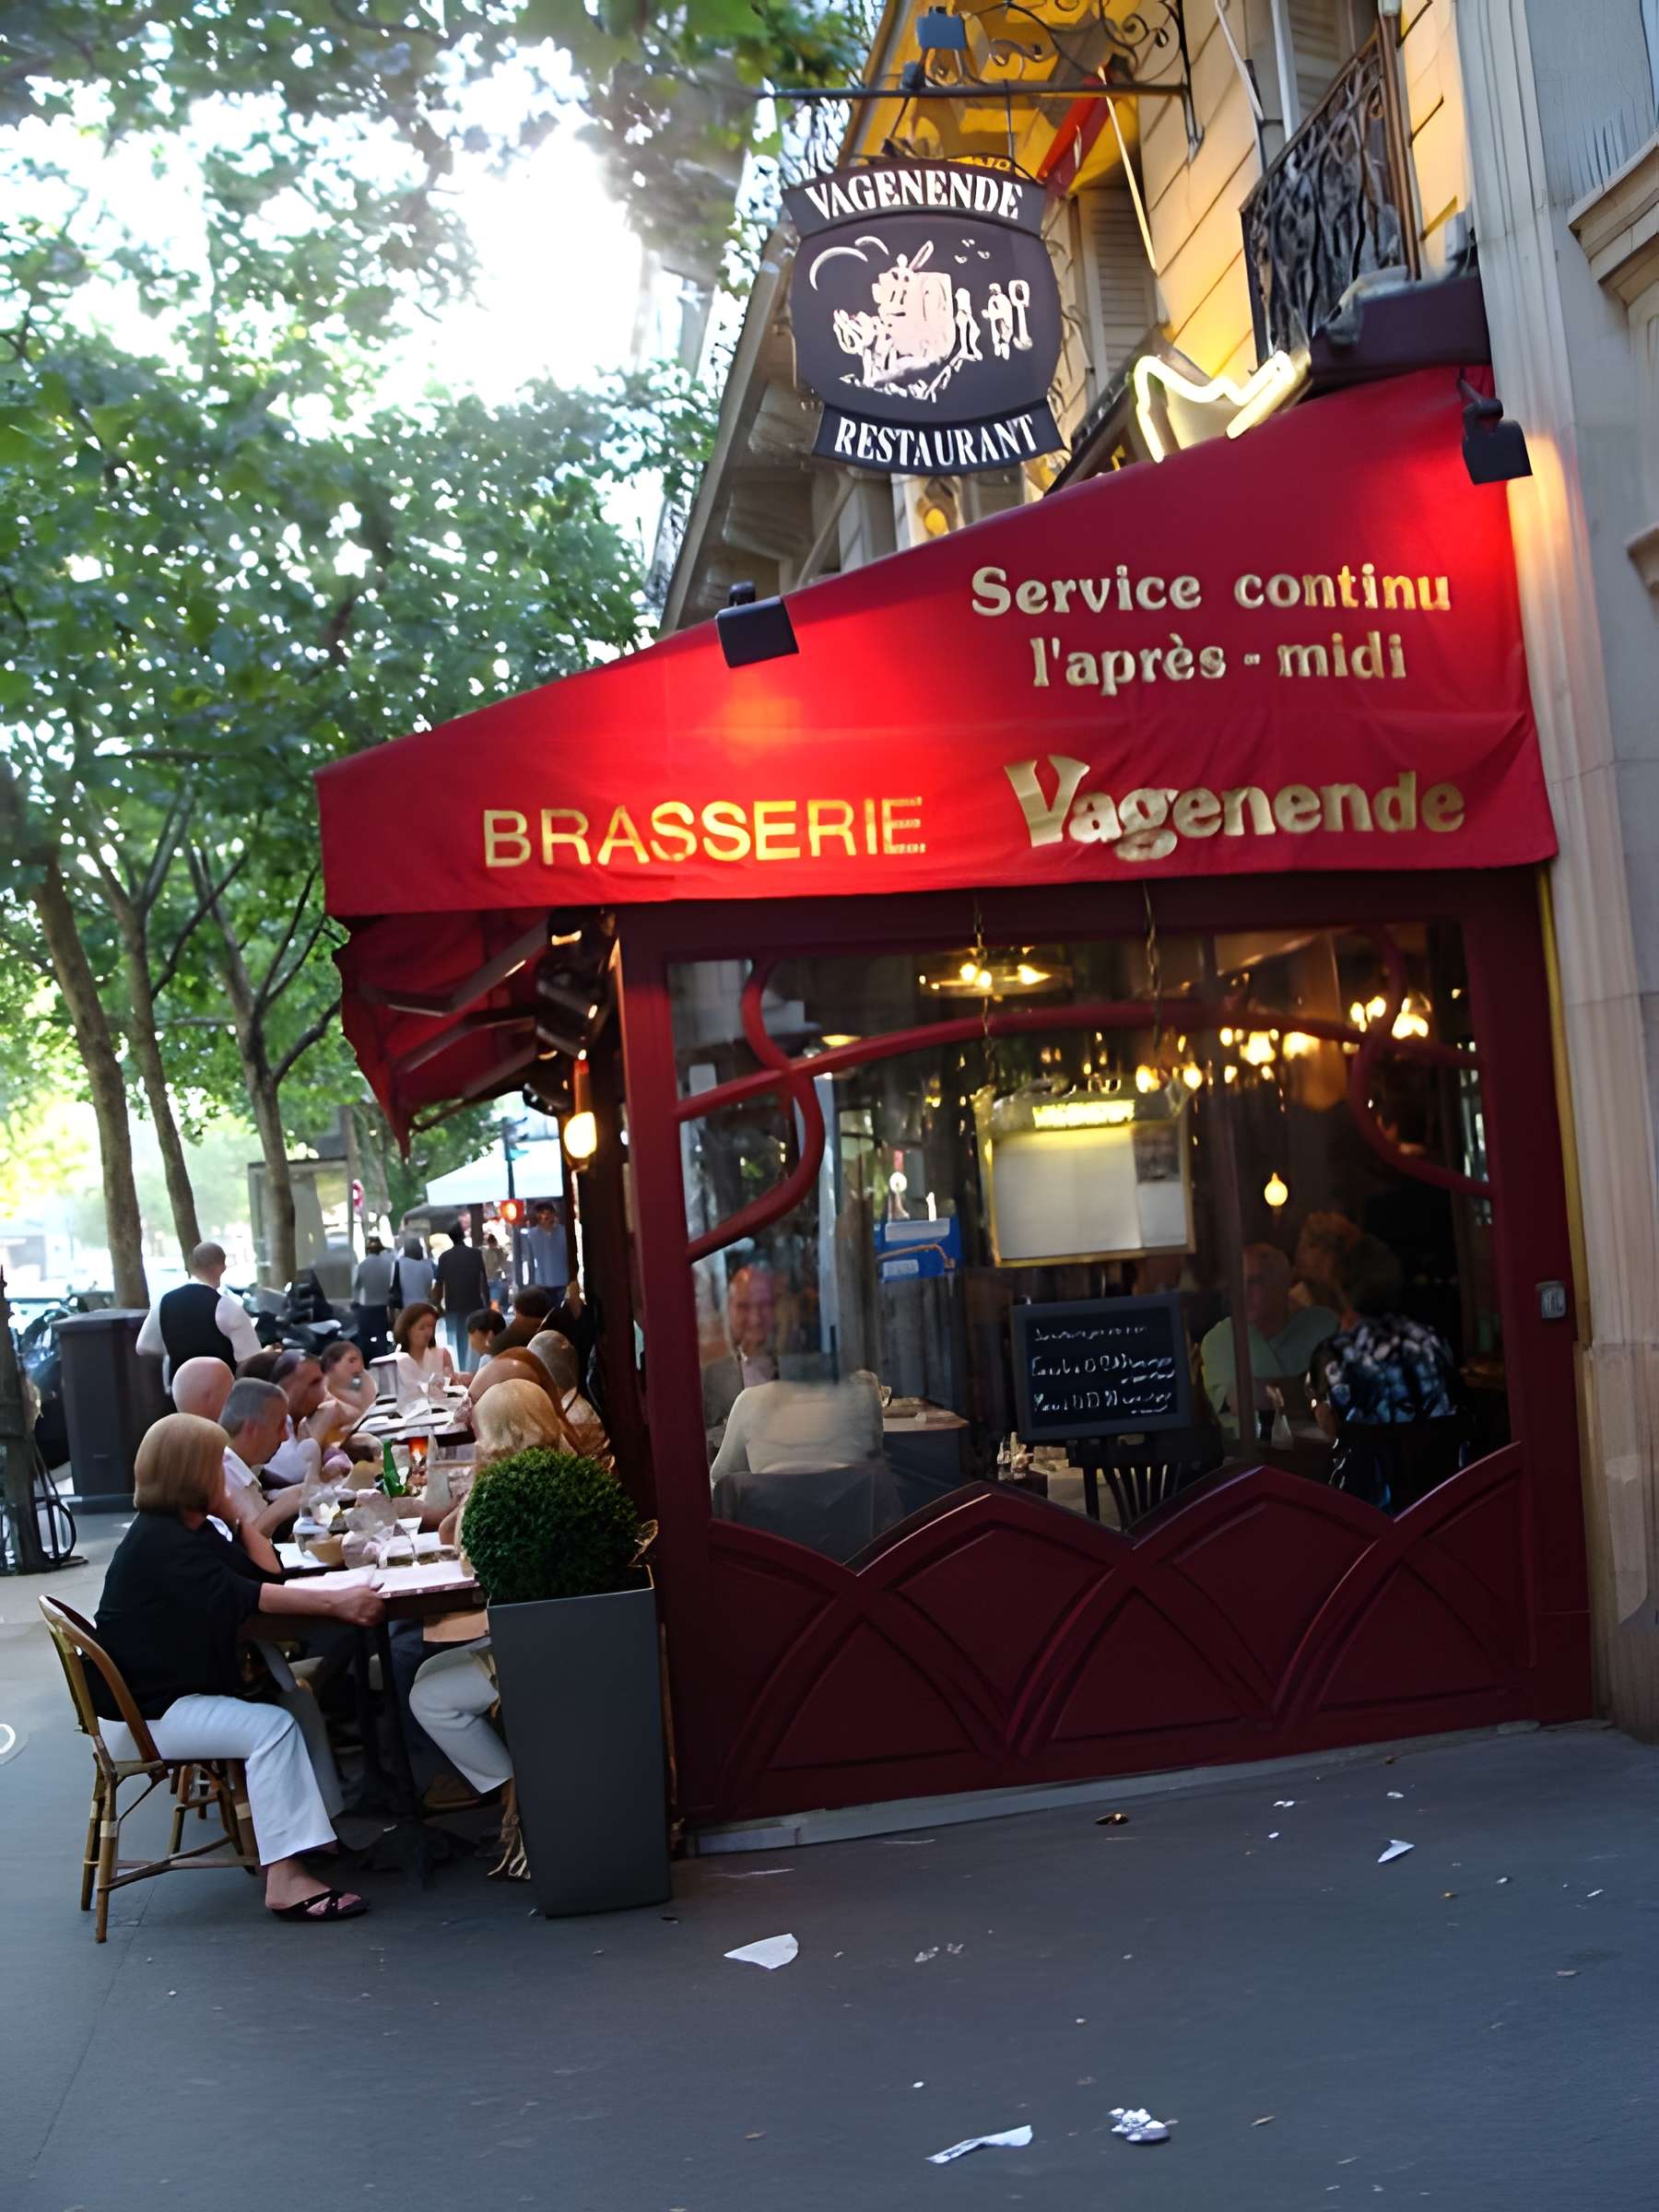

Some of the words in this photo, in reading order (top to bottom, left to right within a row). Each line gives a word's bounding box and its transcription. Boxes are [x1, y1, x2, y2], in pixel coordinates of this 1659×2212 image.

[804, 170, 1024, 220] VAGENENDE
[834, 414, 1038, 468] RESTAURANT
[971, 564, 1202, 618] Service
[1233, 562, 1452, 610] continu
[1030, 632, 1226, 697] l'après
[1277, 630, 1407, 679] midi
[482, 795, 926, 869] BRASSERIE
[1003, 754, 1465, 863] Vagenende
